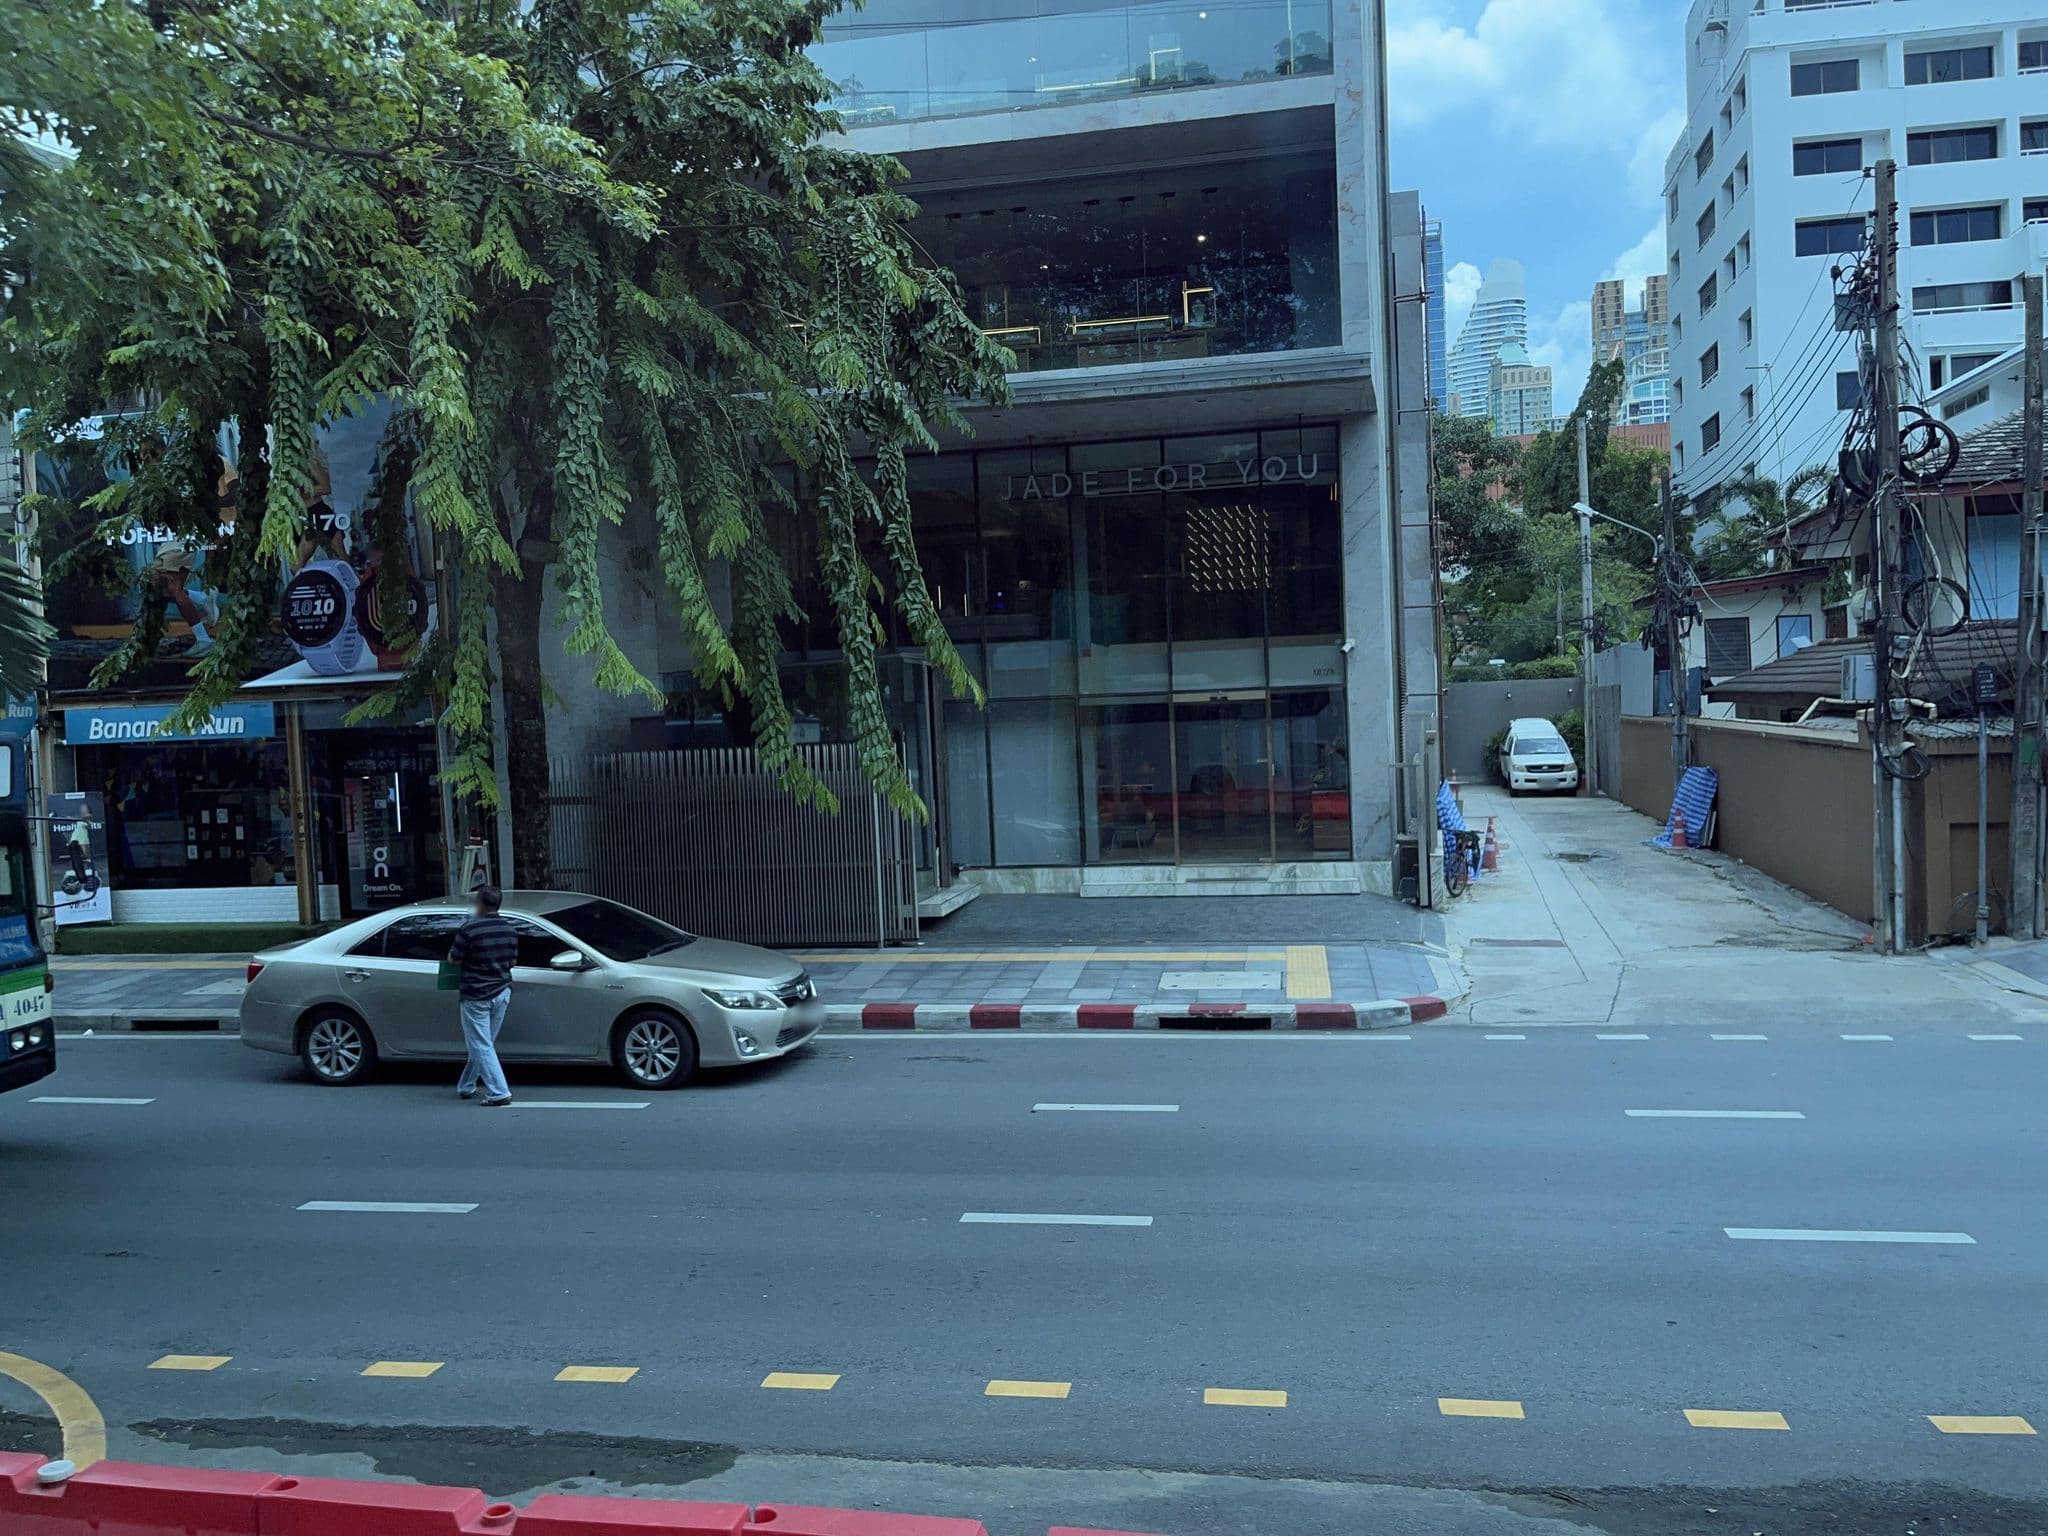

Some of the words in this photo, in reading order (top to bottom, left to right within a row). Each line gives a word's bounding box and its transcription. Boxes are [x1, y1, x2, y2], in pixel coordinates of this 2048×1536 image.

[1001, 471, 1101, 501] JADE
[1127, 464, 1207, 495] FOR
[1236, 453, 1320, 485] YOU
[8, 703, 34, 718] Run
[200, 714, 246, 737] Run
[362, 883, 388, 892] Dream
[13, 994, 44, 1017] 4047
